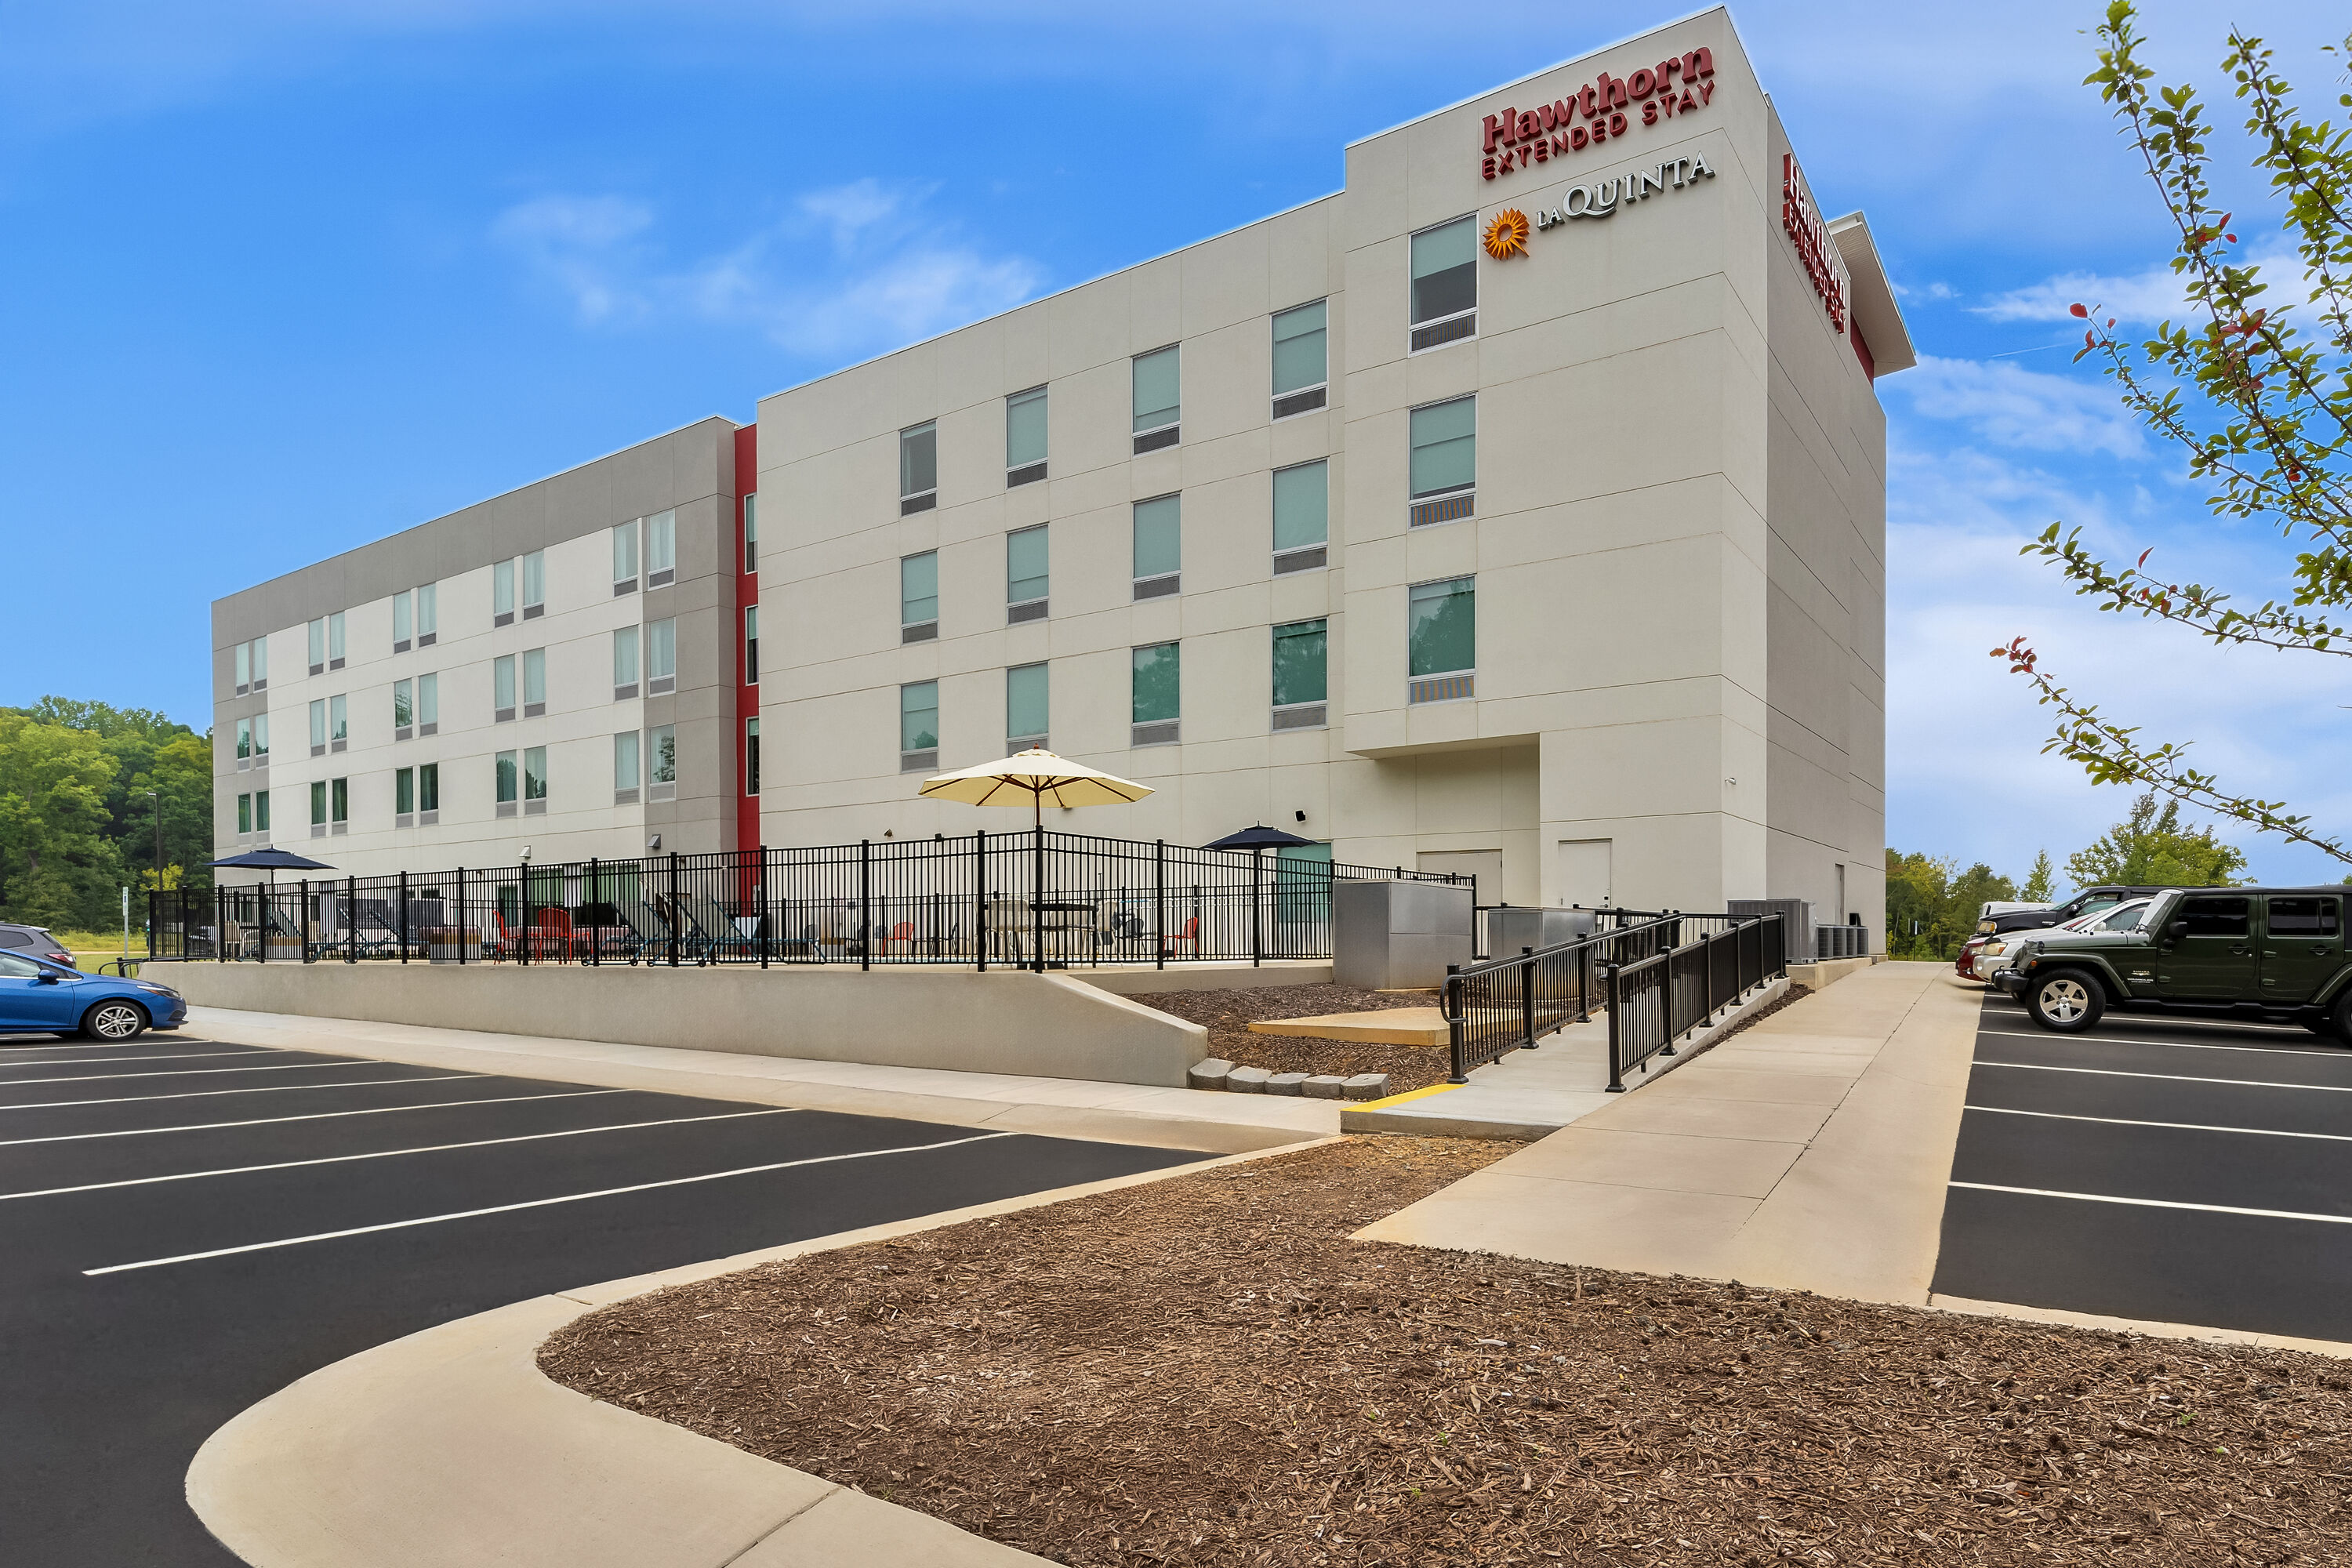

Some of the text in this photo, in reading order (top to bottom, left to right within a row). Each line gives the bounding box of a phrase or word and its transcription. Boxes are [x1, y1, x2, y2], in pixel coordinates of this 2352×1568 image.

[1482, 46, 1715, 154] Hawthorn
[1482, 79, 1715, 180] EXTENDED STAY
[1537, 150, 1716, 231] LA QUINTA
[1783, 152, 1846, 310] Hawthorn
[1783, 202, 1846, 334] EXTENDED STAY
